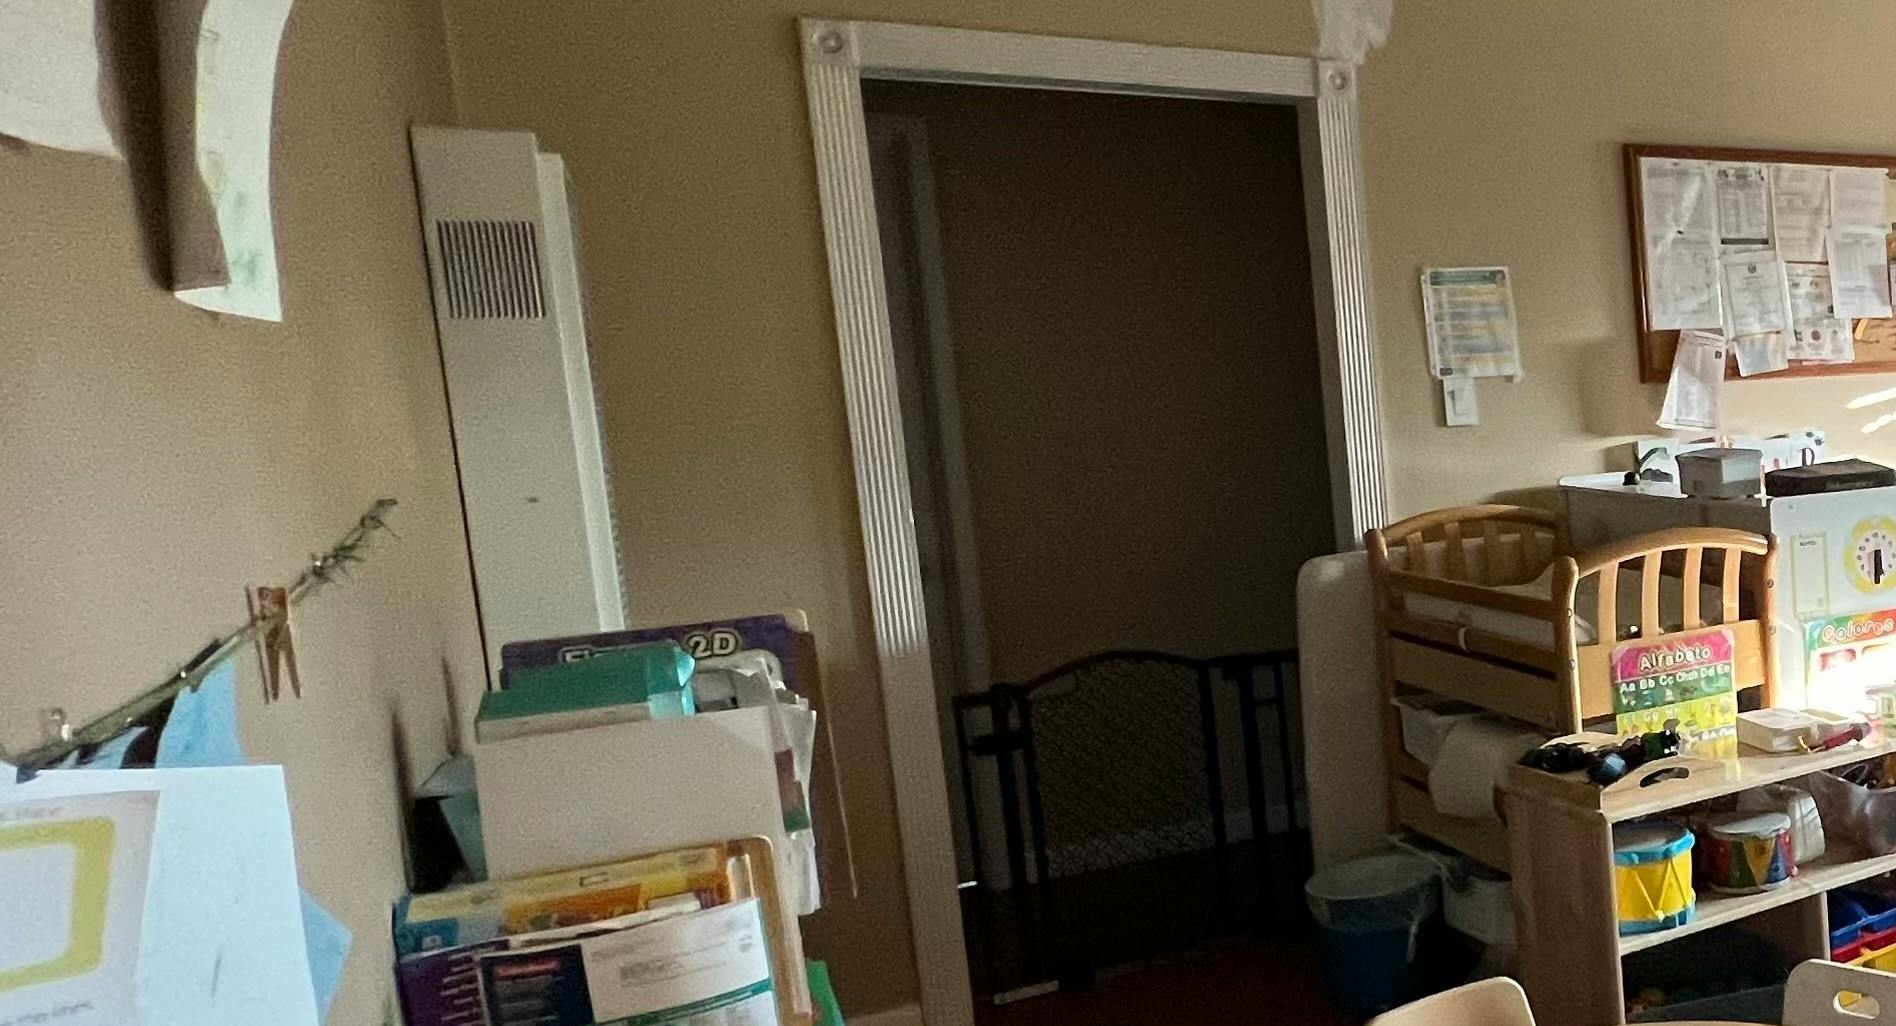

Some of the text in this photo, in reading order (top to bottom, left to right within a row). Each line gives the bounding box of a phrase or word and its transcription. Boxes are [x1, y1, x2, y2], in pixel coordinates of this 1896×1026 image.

[1822, 618, 1894, 642] Colores
[685, 630, 740, 659] 2D
[1640, 645, 1712, 671] Alfabeto
